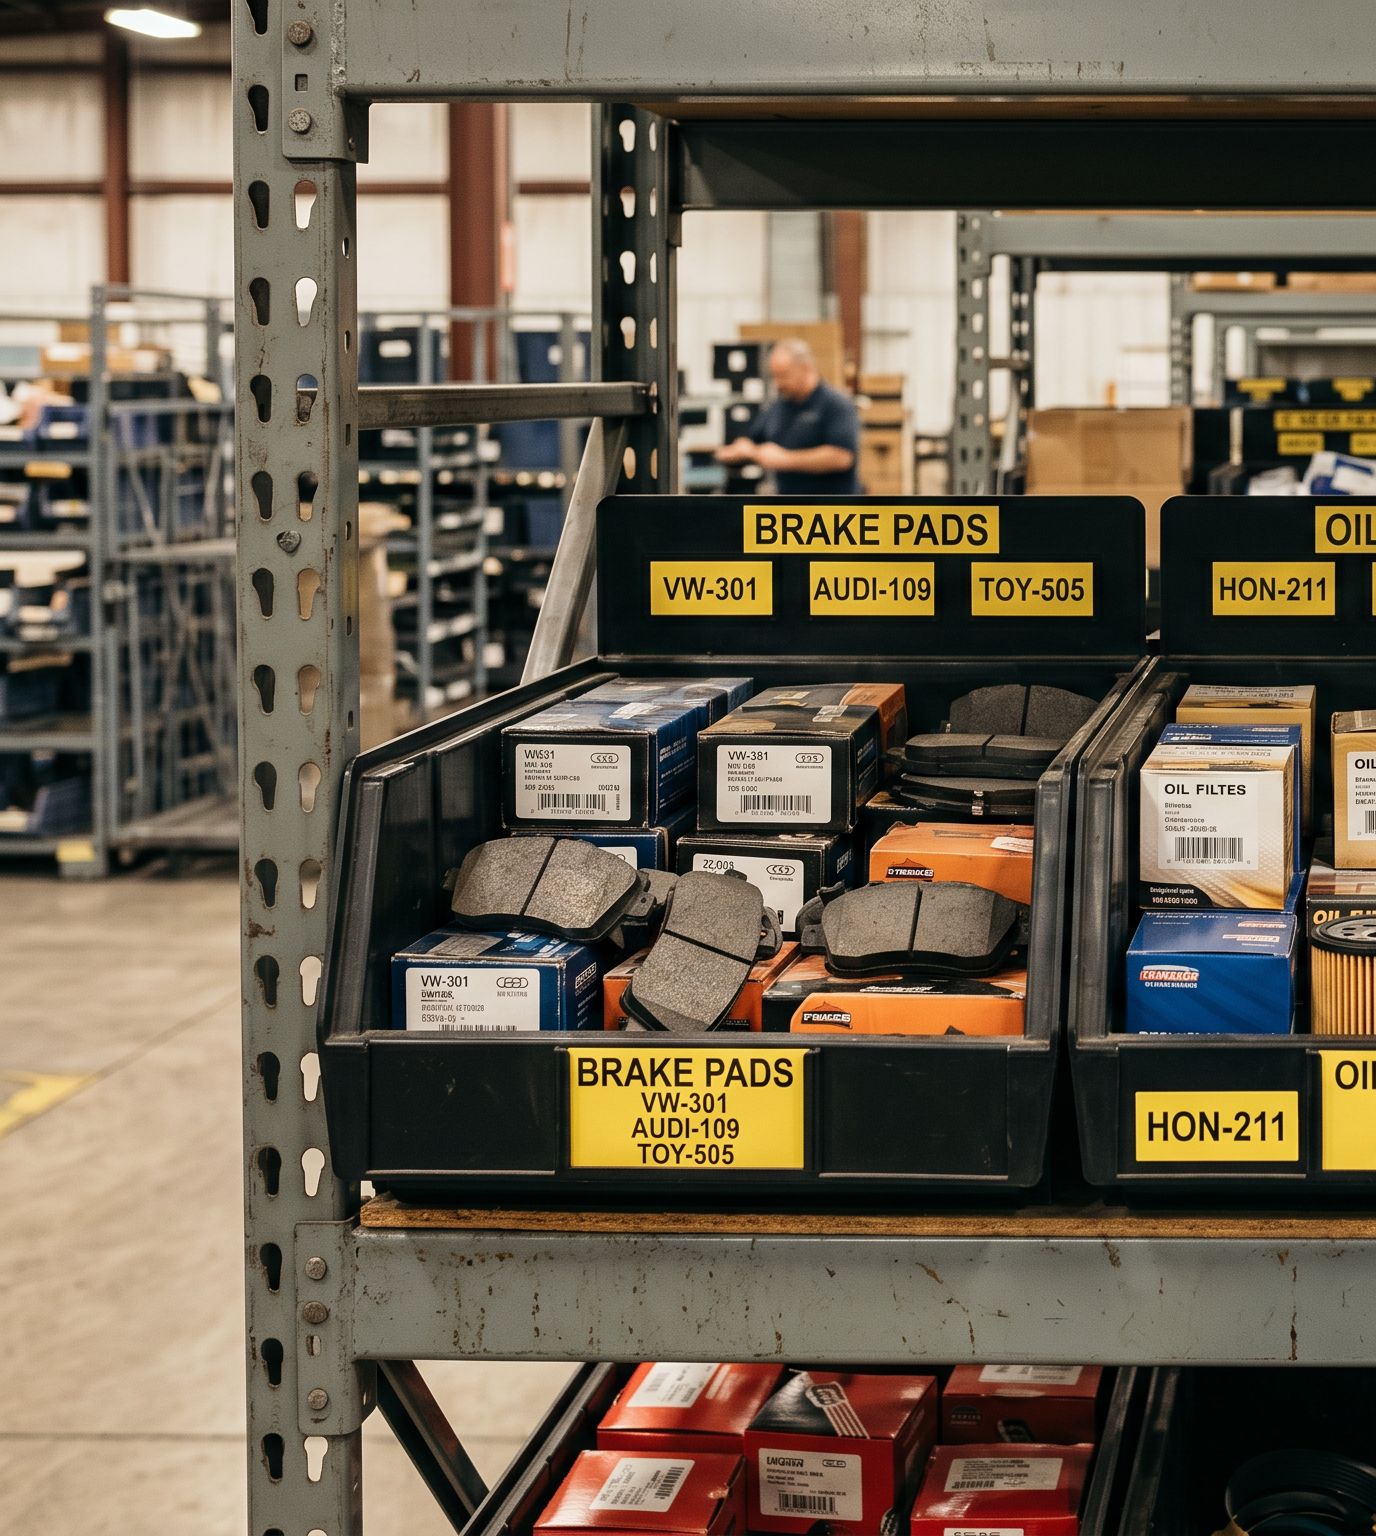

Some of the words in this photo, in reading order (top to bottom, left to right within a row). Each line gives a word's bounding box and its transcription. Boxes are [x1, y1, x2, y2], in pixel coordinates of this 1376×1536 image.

[756, 514, 880, 546] BRAKE
[893, 513, 989, 547] PADS
[662, 576, 756, 601] VW-301
[813, 576, 931, 602] AUDI-109
[978, 577, 1085, 602] TOY-505
[1219, 576, 1326, 602] HON-211
[728, 751, 768, 762] VW-381
[1164, 783, 1190, 795] OIL
[1195, 784, 1247, 796] FILTES
[420, 975, 469, 988] VW-301
[577, 1057, 694, 1088] BRAKE
[705, 1057, 794, 1088] PADS
[640, 1092, 726, 1114] VW-301
[631, 1117, 740, 1140] AUDI-109
[1148, 1110, 1284, 1142] HON-211
[636, 1143, 735, 1165] TOY-505
